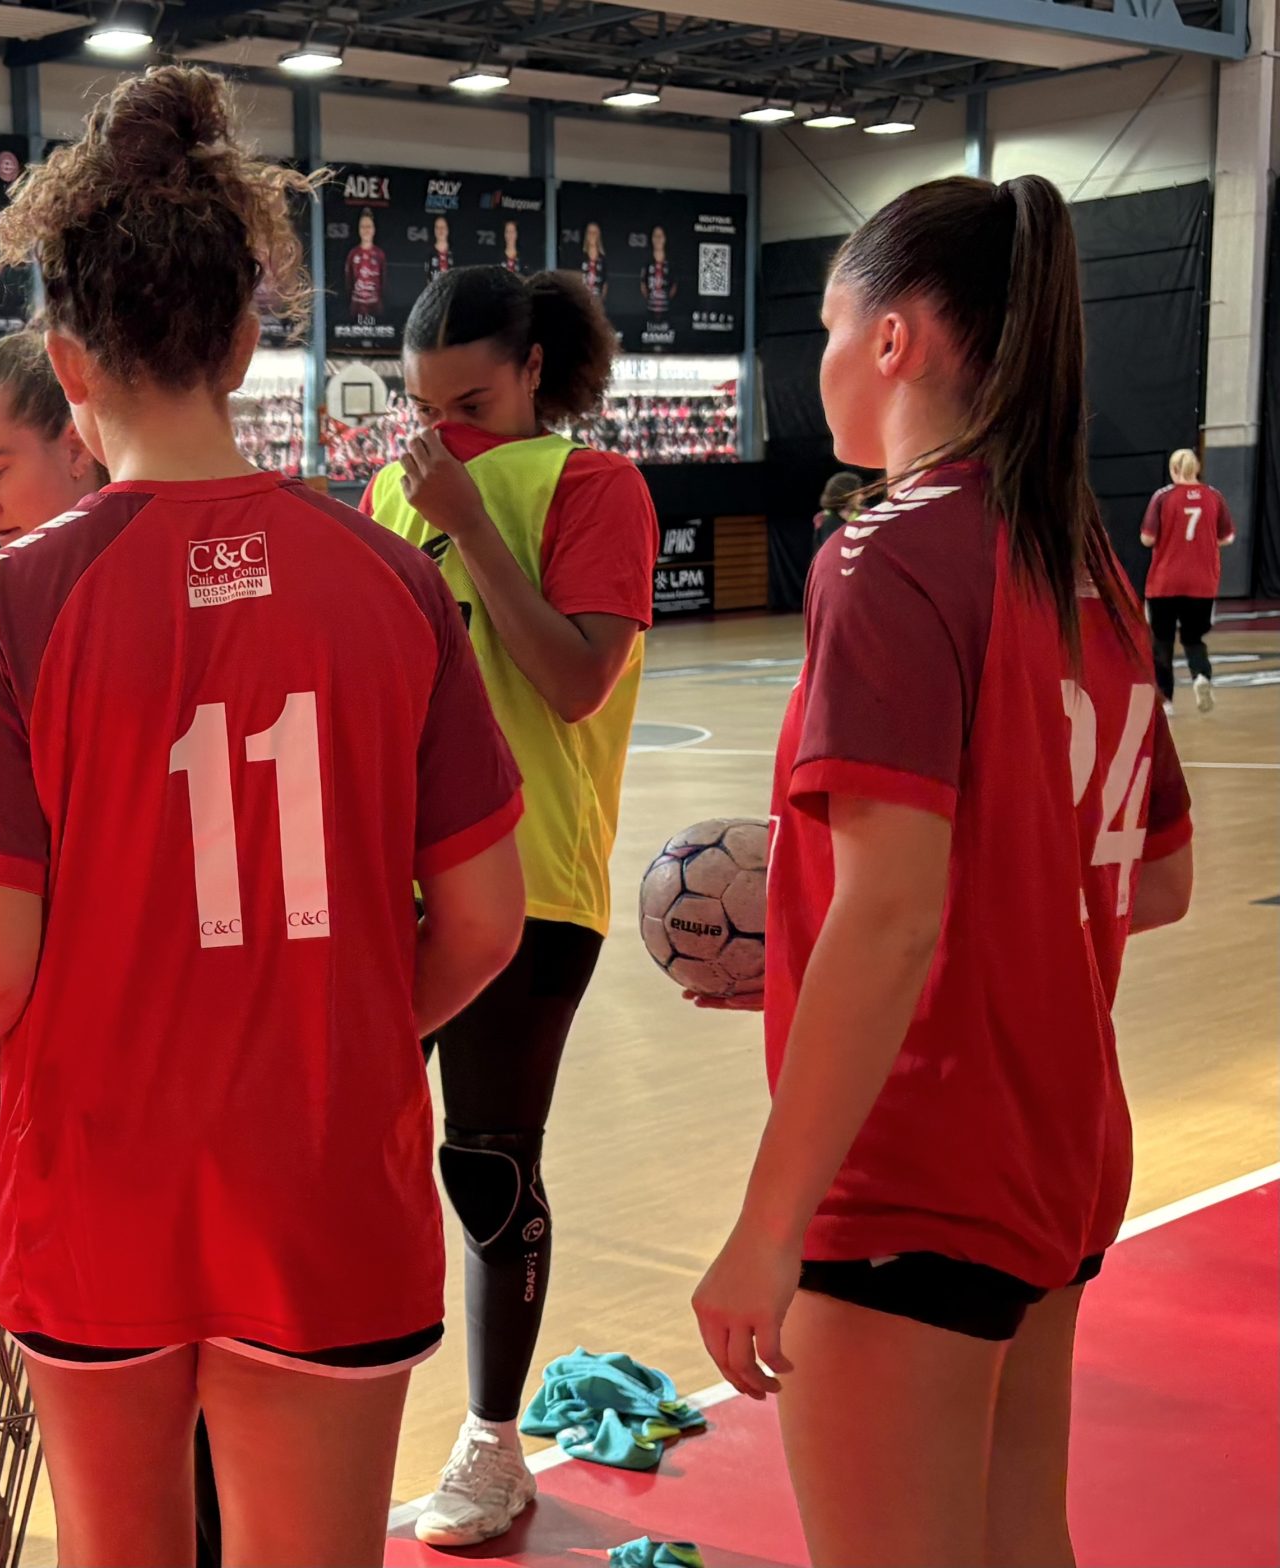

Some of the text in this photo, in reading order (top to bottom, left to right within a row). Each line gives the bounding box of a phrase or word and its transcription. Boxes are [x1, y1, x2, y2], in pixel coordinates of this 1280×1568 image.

[1184, 506, 1202, 541] 7
[190, 537, 264, 573] C&C
[189, 566, 266, 586] Cuir et Coton
[670, 569, 704, 588] LPM
[194, 578, 263, 599] DOSSMANN
[169, 691, 331, 949] 11
[201, 919, 241, 936] C&C
[288, 910, 328, 927] C&C
[671, 917, 723, 936] erima
